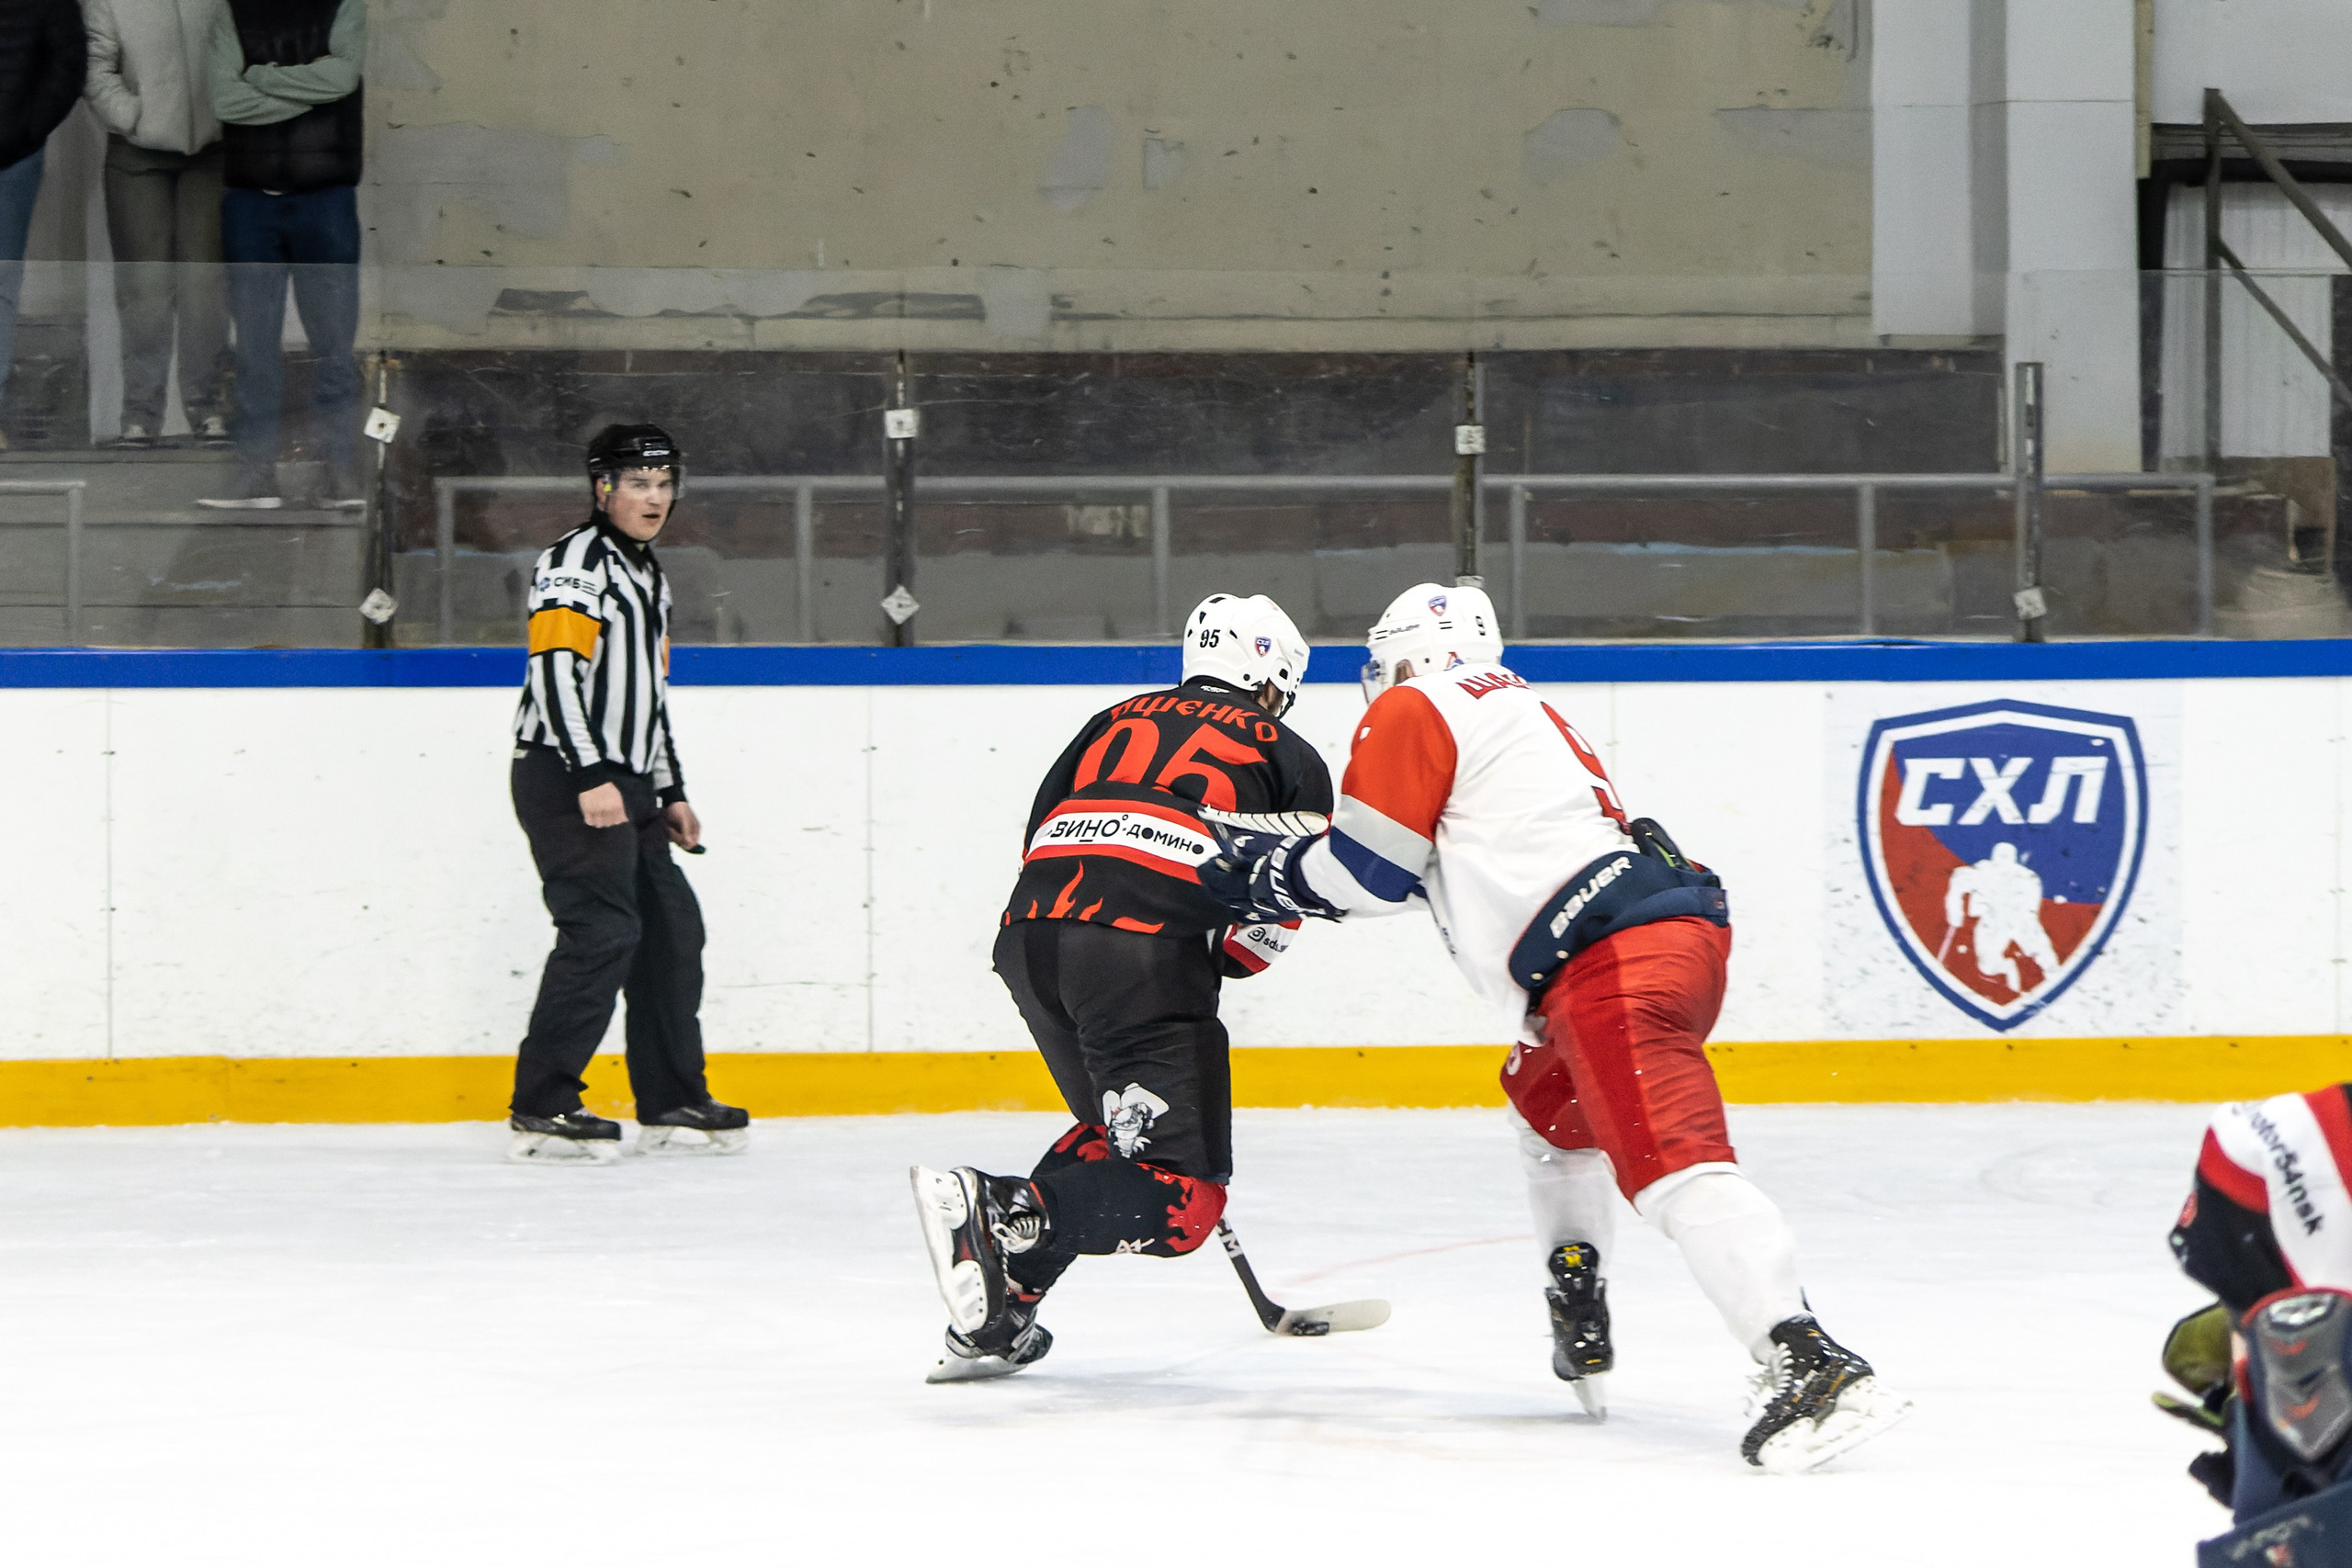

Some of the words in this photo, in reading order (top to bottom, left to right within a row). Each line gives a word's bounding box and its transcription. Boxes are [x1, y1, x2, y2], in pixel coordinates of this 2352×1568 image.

[1199, 629, 1221, 649] 95
[1894, 755, 2109, 827] СХЛ
[1549, 856, 1633, 939] BAUER
